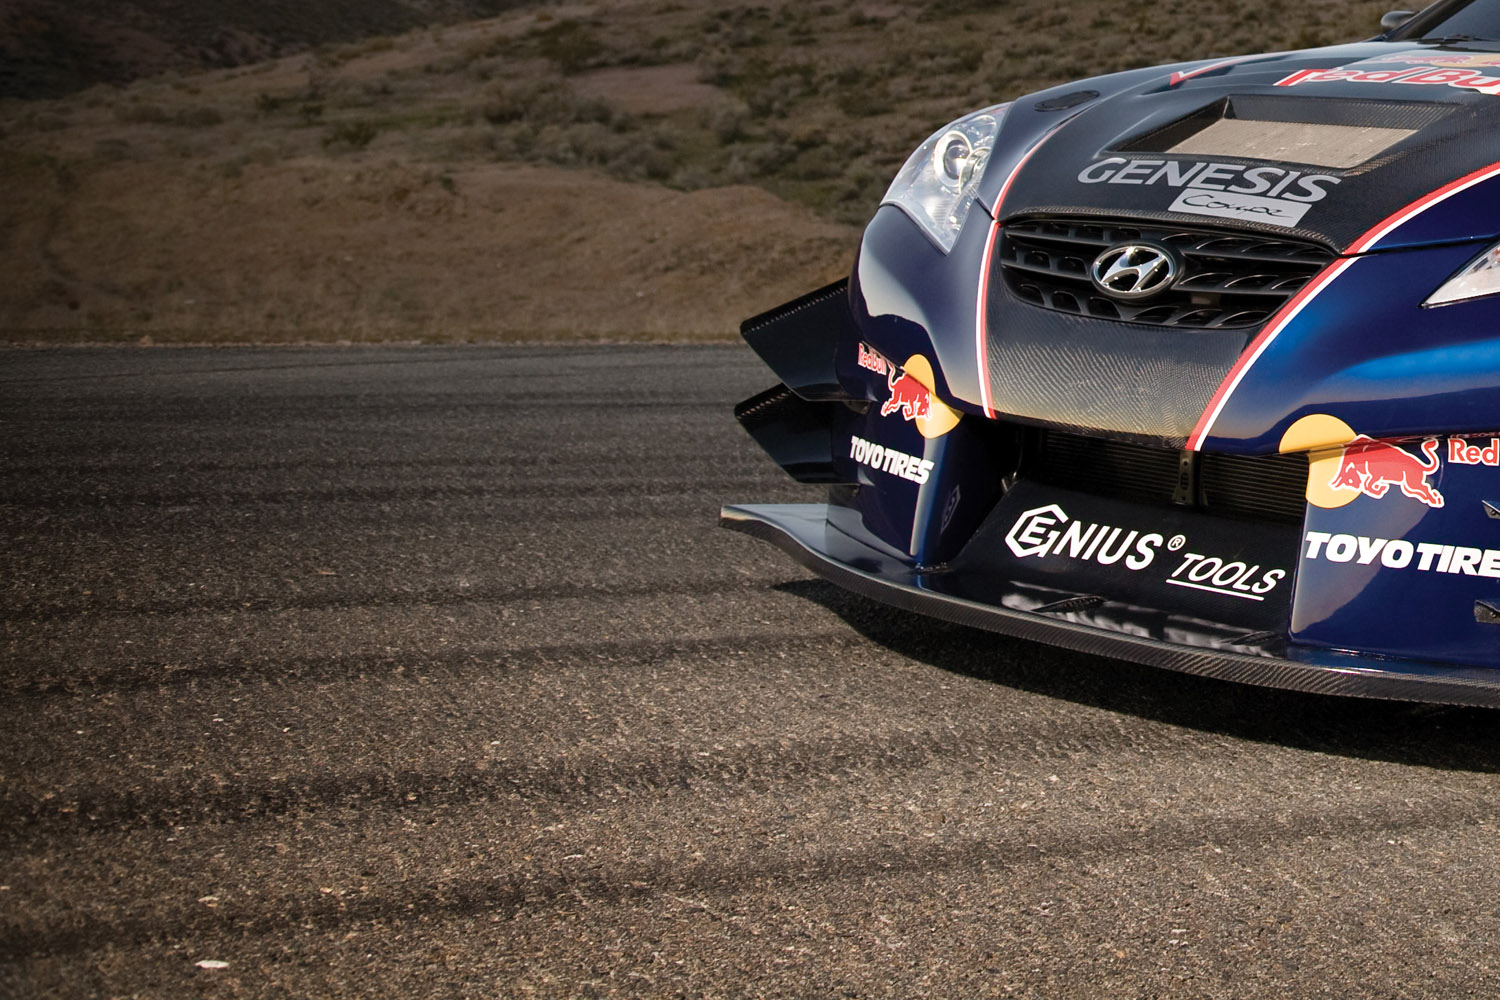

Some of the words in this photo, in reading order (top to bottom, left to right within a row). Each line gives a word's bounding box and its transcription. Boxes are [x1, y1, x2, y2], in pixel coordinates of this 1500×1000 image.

[1077, 156, 1342, 203] GENESIS
[1181, 192, 1295, 219] Coupe
[850, 435, 885, 470] TOYO
[882, 448, 935, 485] TIRES
[1304, 531, 1418, 570] TOYO
[1170, 552, 1286, 594] TOOLS
